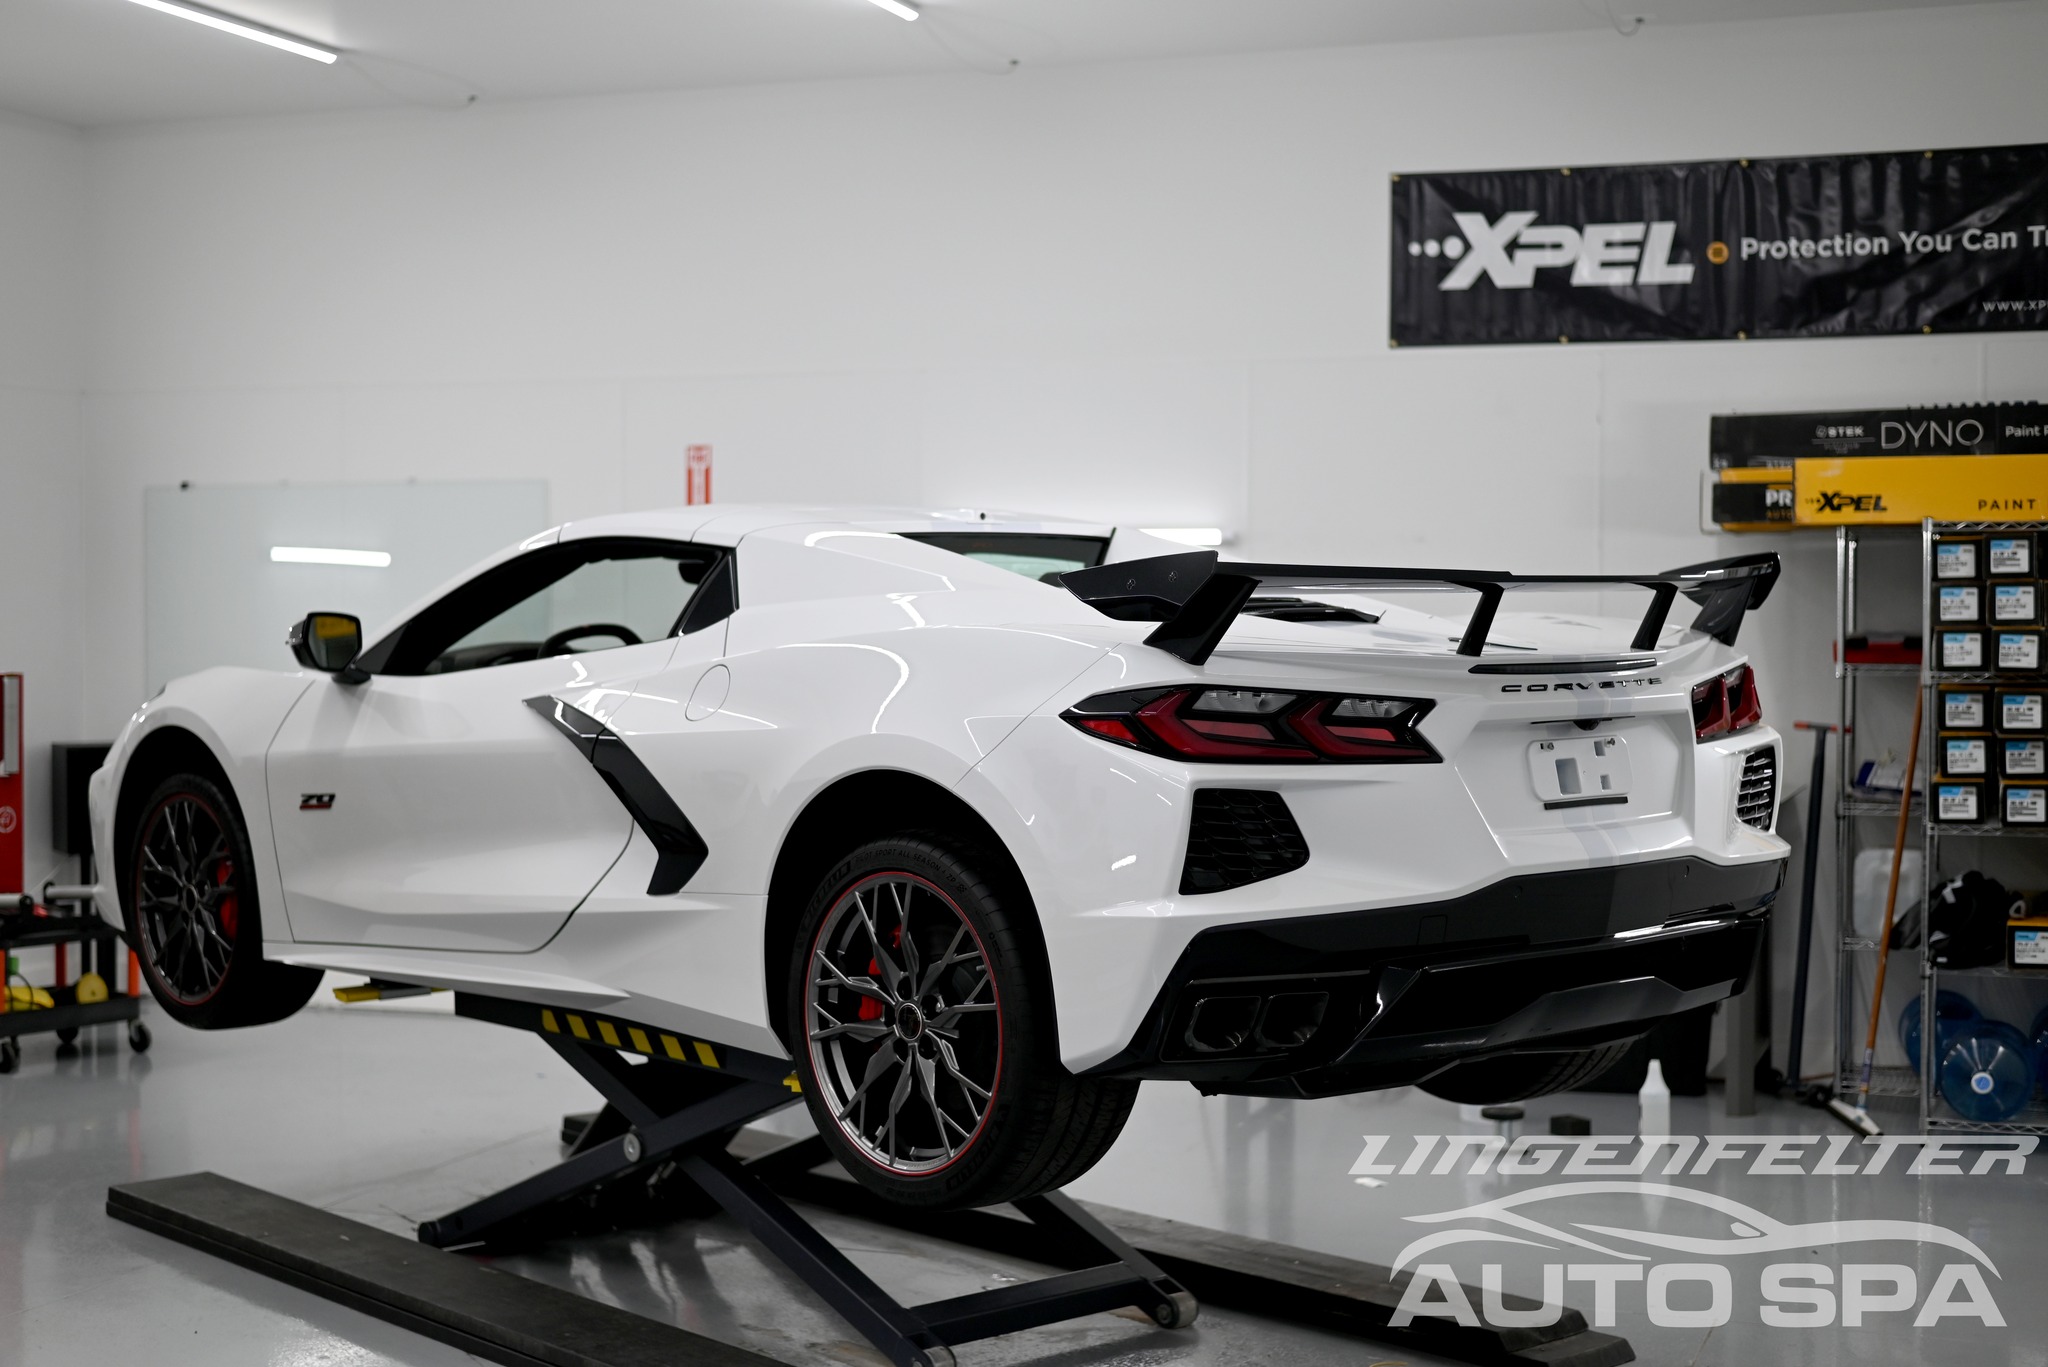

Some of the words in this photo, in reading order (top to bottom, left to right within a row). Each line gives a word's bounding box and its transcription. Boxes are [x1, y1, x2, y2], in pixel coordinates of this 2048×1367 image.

[1439, 211, 1695, 291] XPEL
[1740, 232, 1890, 260] Protection
[1898, 230, 1953, 254] You
[1962, 227, 2018, 251] Can
[1881, 418, 1984, 450] DYNO
[2005, 424, 2040, 438] Paint
[1816, 491, 1888, 513] XPEL
[1978, 498, 2036, 511] PAINT
[1501, 677, 1662, 693] CORVETTE
[898, 849, 910, 859] ALL
[913, 853, 941, 872] SEASON
